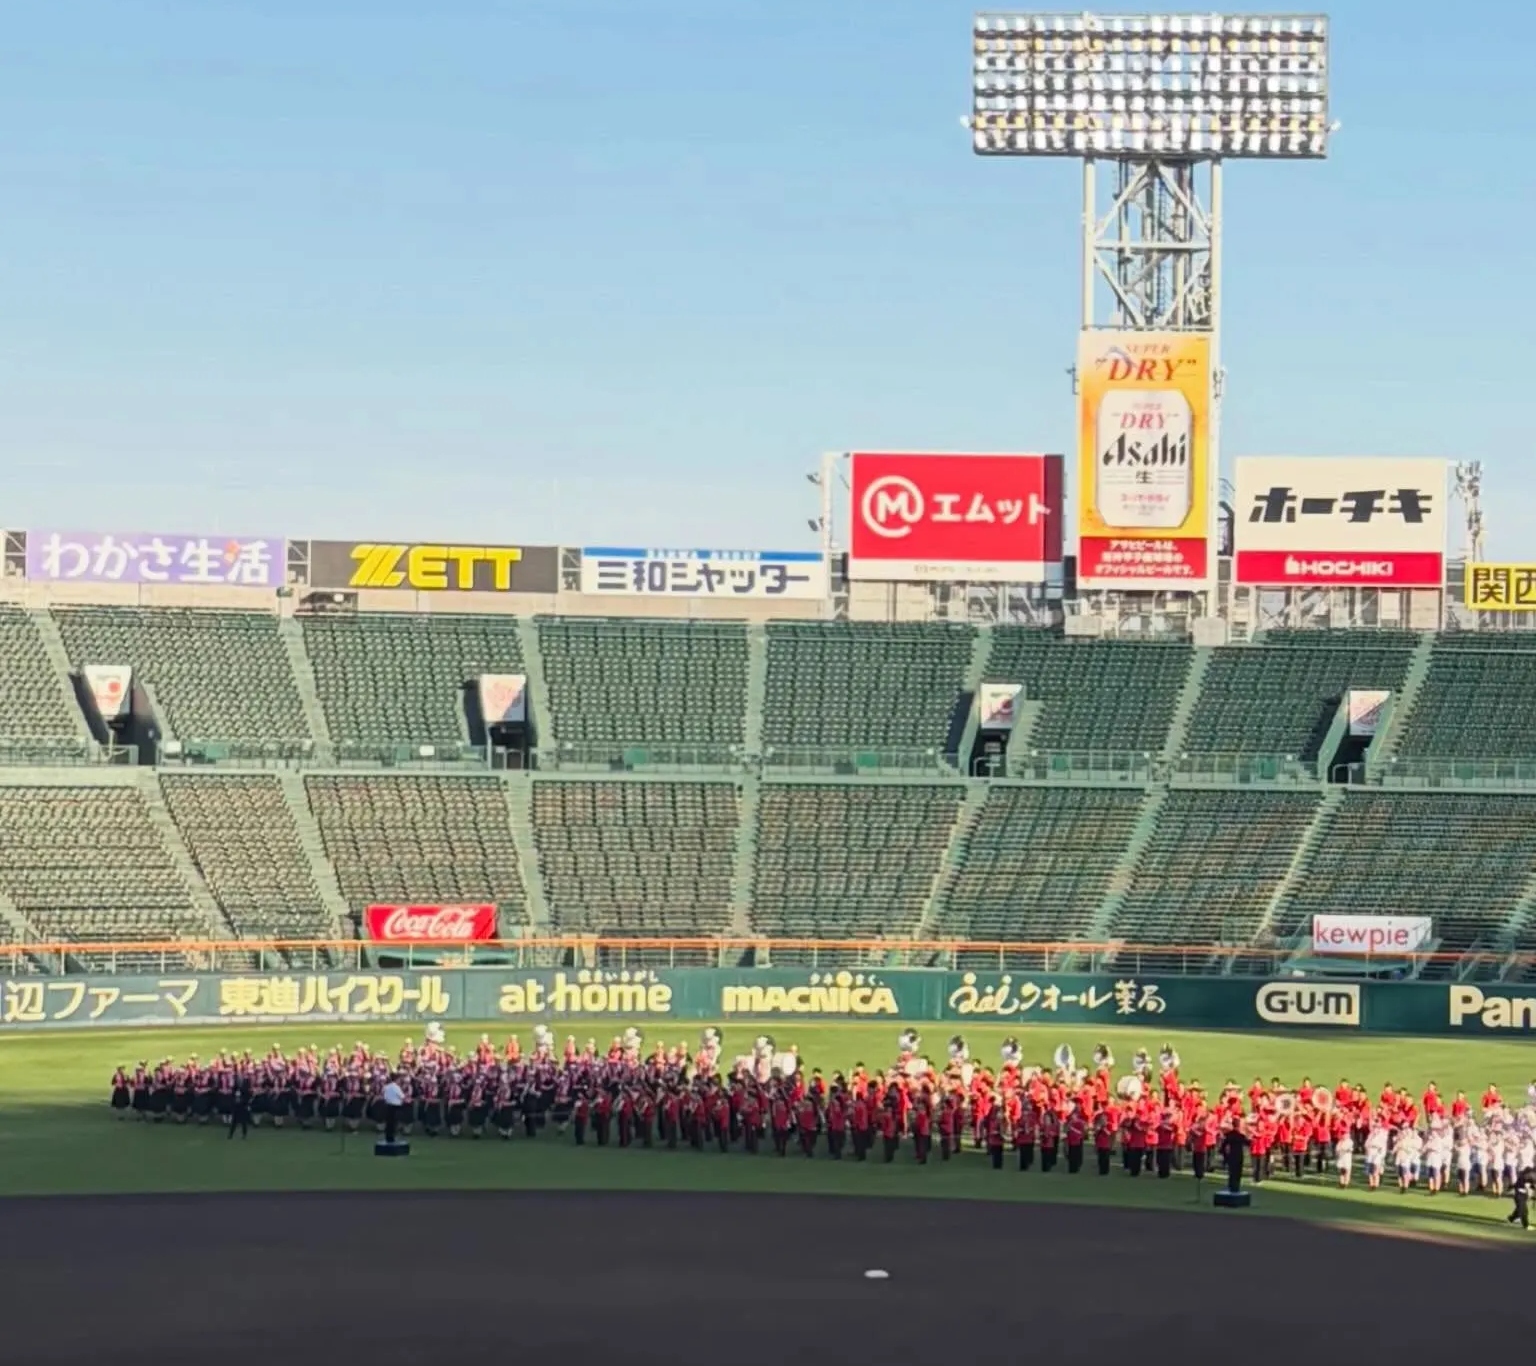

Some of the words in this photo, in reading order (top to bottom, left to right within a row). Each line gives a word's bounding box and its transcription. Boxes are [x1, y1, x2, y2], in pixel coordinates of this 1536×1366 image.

[1102, 432, 1186, 466] Asahi
[930, 492, 1051, 525] エムット
[1249, 487, 1432, 523] ホーチキ
[41, 533, 272, 583] わかさ生活
[348, 544, 522, 591] ZETT
[1300, 560, 1393, 576] HOCHIKI
[597, 561, 810, 594] 三和シャッター
[1315, 921, 1409, 952] kewpie
[0, 979, 199, 1022] 辺ファーマ
[221, 976, 449, 1014] 東進ハイスクール
[547, 973, 672, 1012] home
